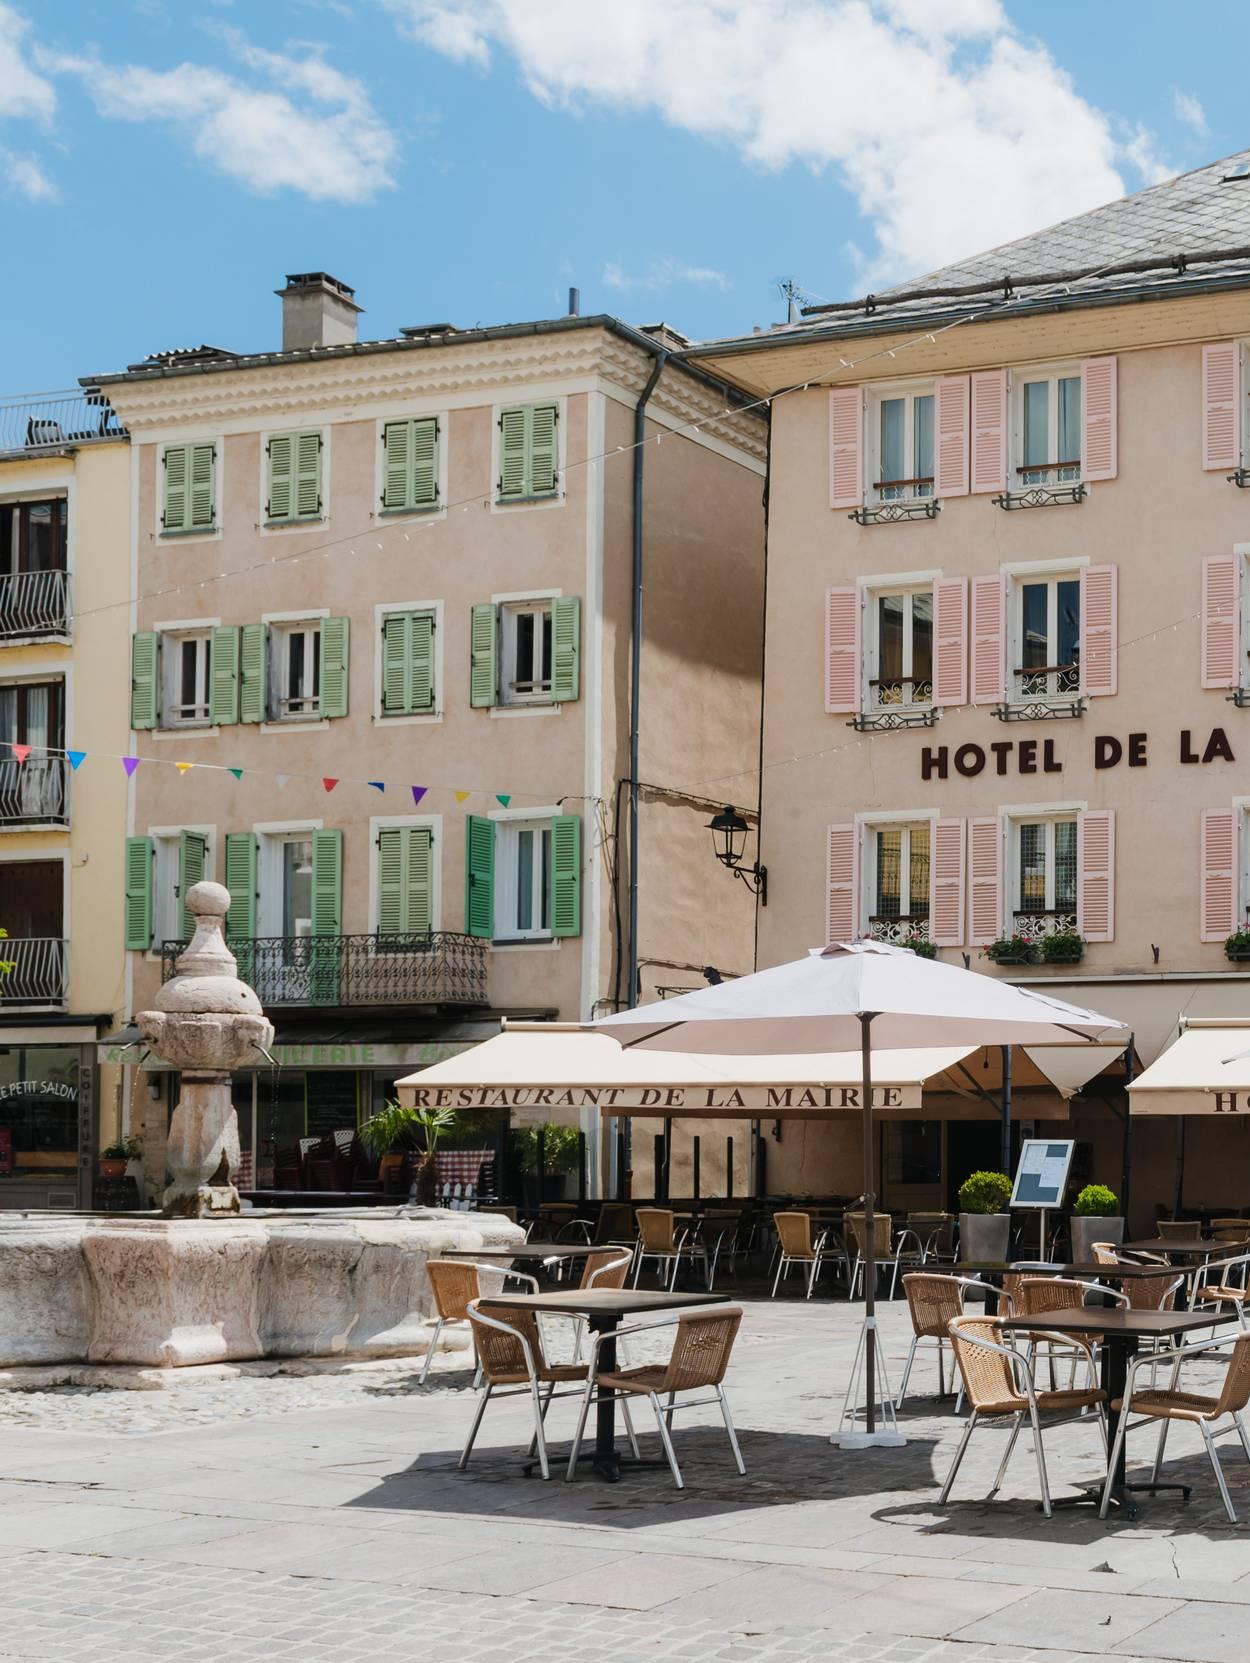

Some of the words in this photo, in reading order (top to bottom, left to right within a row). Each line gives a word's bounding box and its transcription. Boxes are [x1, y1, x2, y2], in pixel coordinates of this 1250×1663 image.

[921, 739, 1063, 781] HOTEL
[1094, 732, 1148, 770] DE
[1180, 727, 1236, 764] LA
[9, 1080, 37, 1096] PETIT
[39, 1080, 78, 1101] SALON
[413, 1087, 625, 1108] RESTAURANT
[639, 1088, 685, 1107] DE
[705, 1088, 747, 1107] LA
[82, 1068, 91, 1168] COIFFURE
